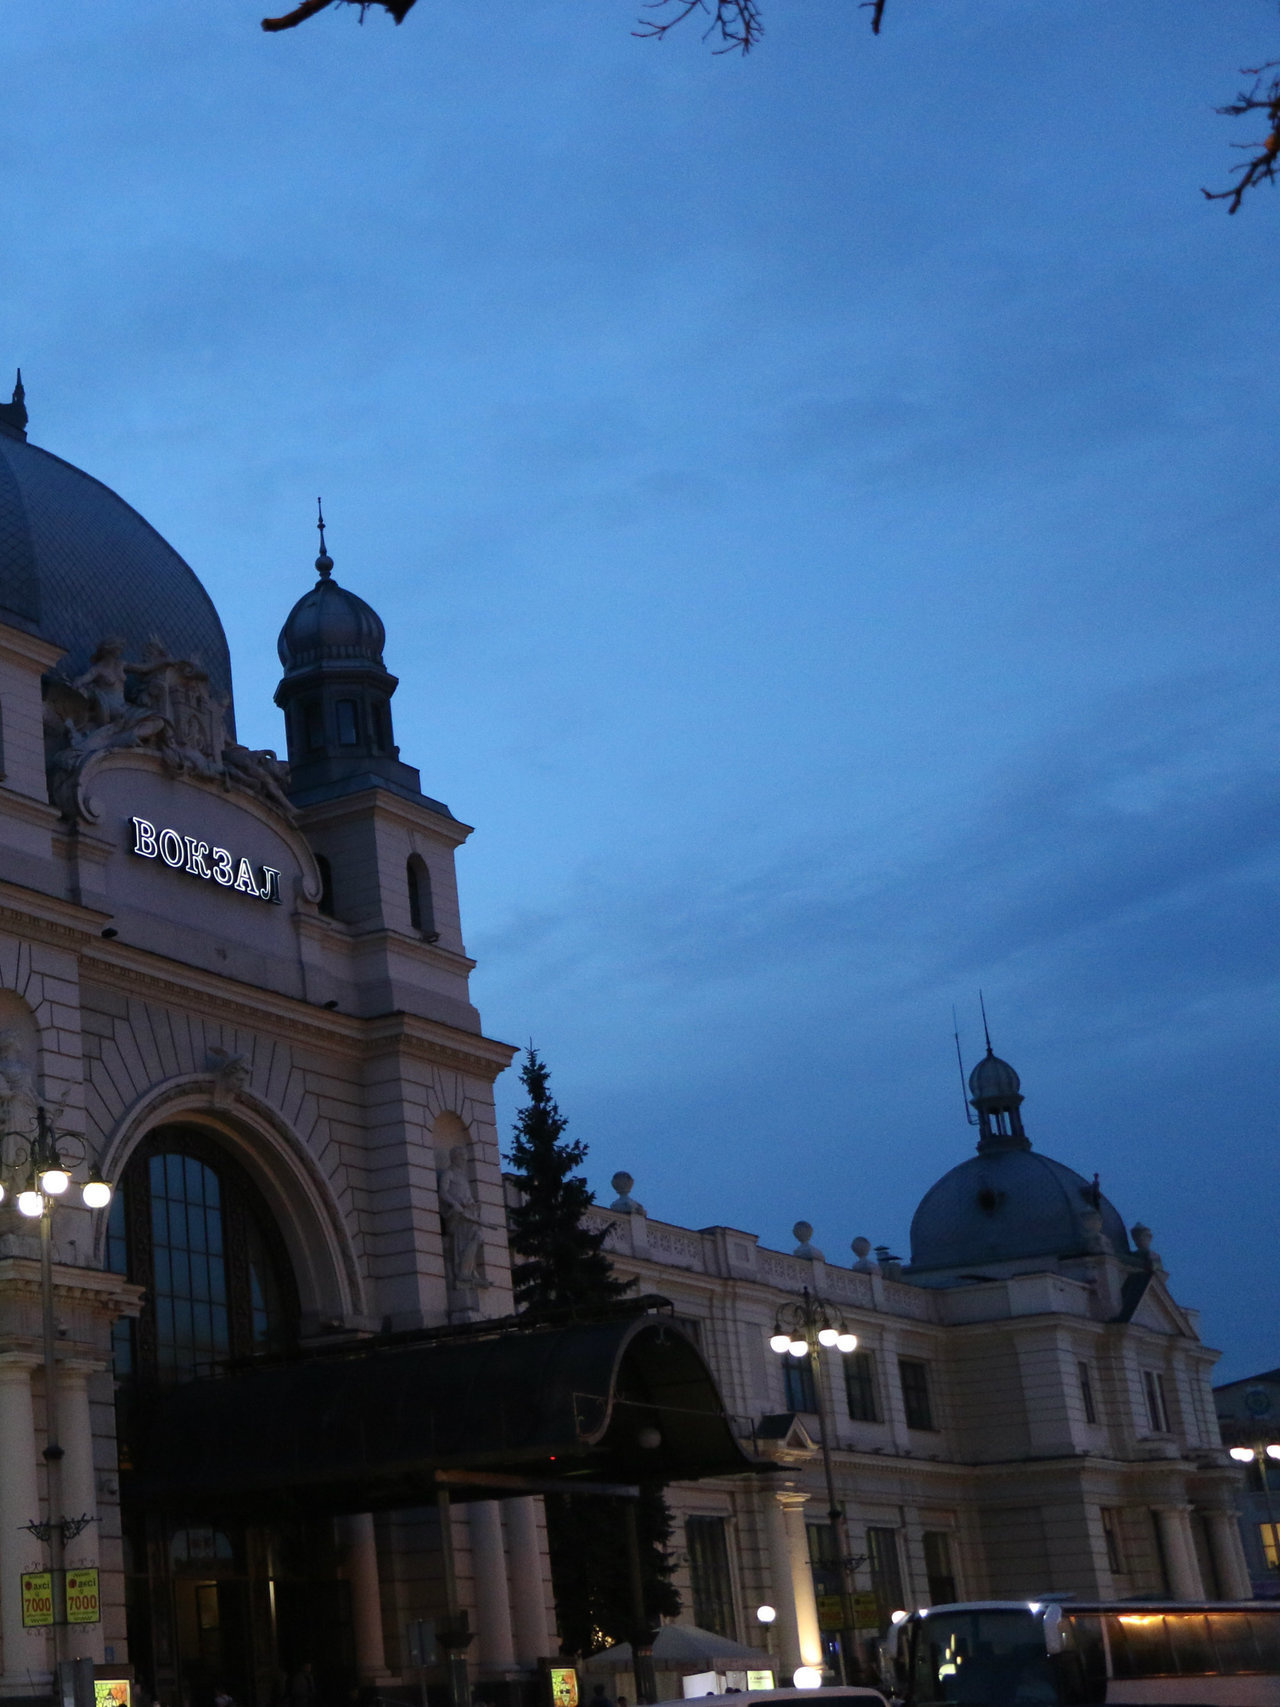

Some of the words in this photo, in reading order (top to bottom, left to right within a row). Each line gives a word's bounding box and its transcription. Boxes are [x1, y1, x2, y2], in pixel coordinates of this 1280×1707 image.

[129, 816, 282, 904] ВОКЗАЛ
[25, 1598, 51, 1612] 7000
[69, 1595, 97, 1610] 7000
